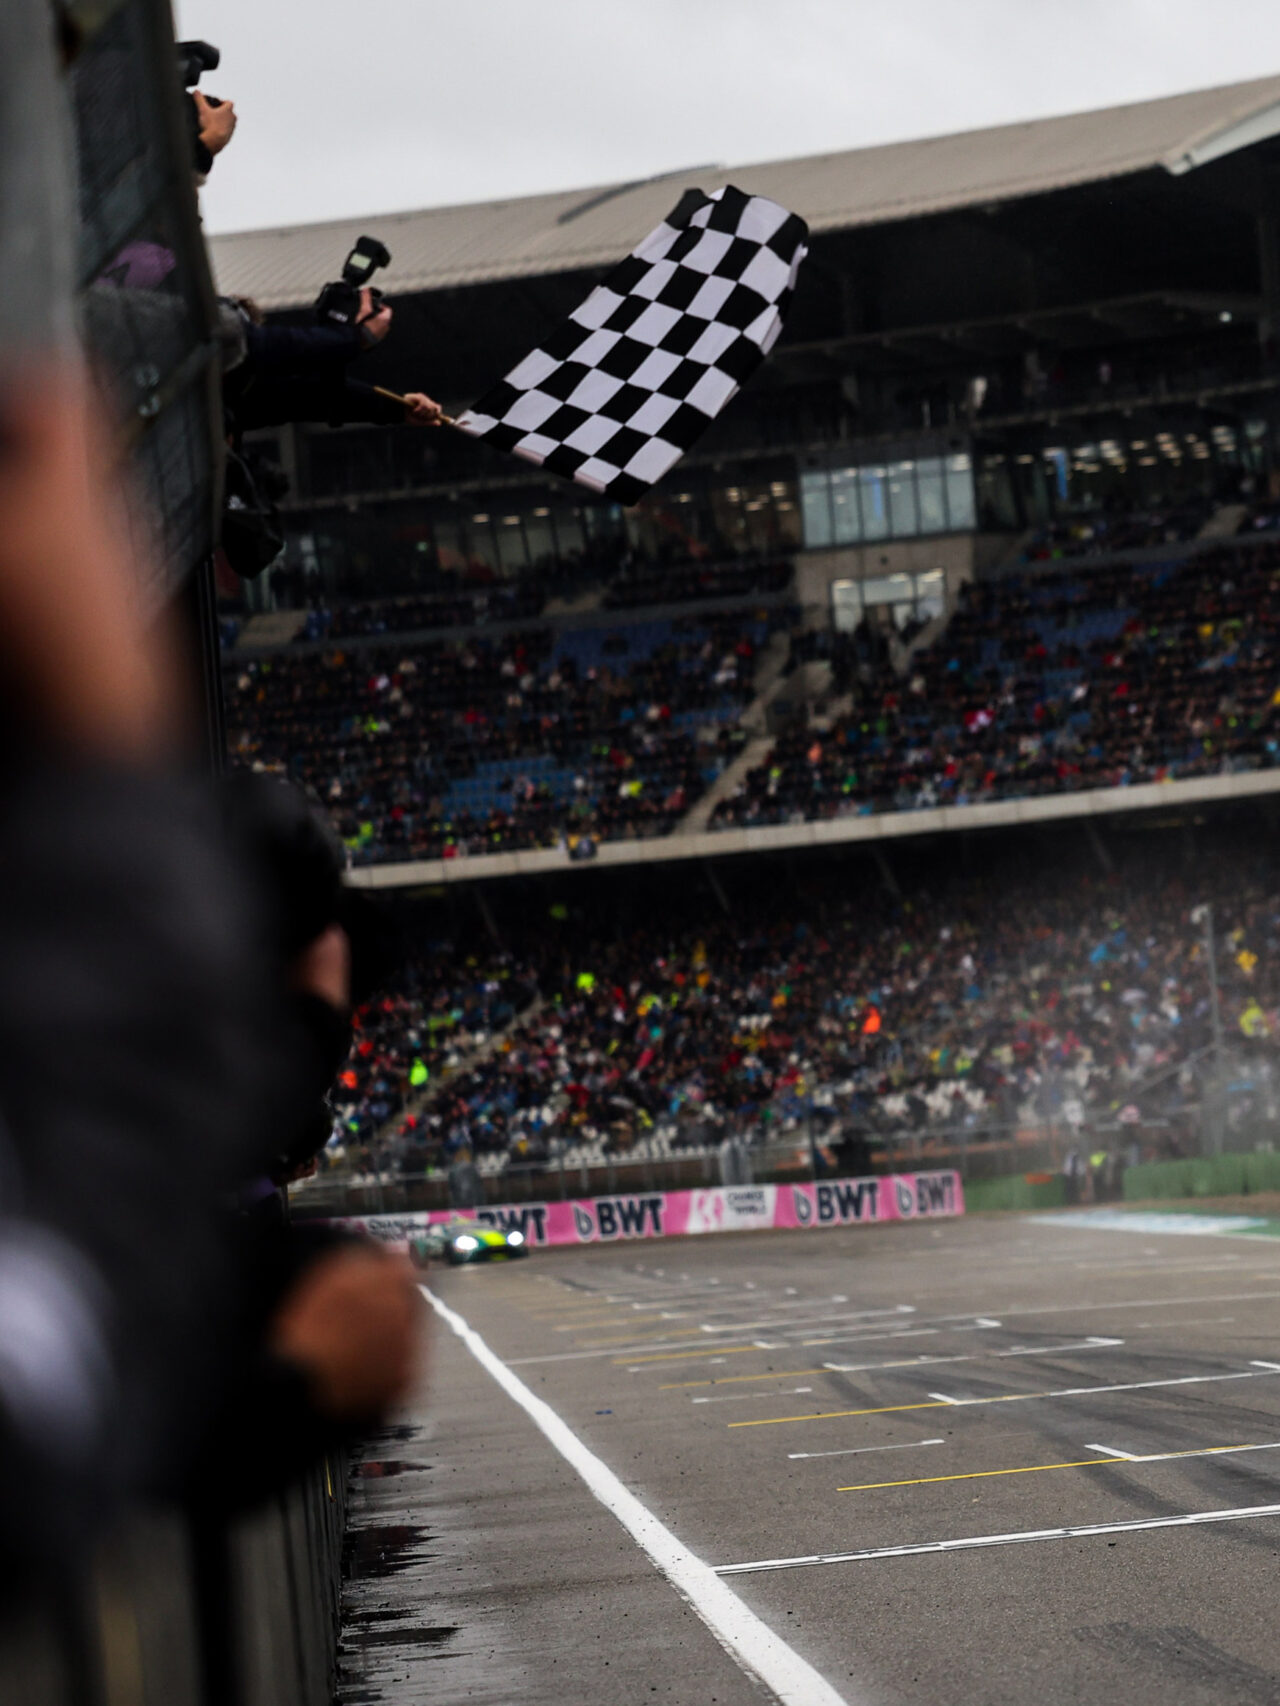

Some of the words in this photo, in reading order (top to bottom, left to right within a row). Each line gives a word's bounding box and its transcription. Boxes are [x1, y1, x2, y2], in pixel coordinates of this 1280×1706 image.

[816, 1181, 878, 1221] BWT
[916, 1175, 955, 1213] BWT
[595, 1198, 663, 1236] BWT
